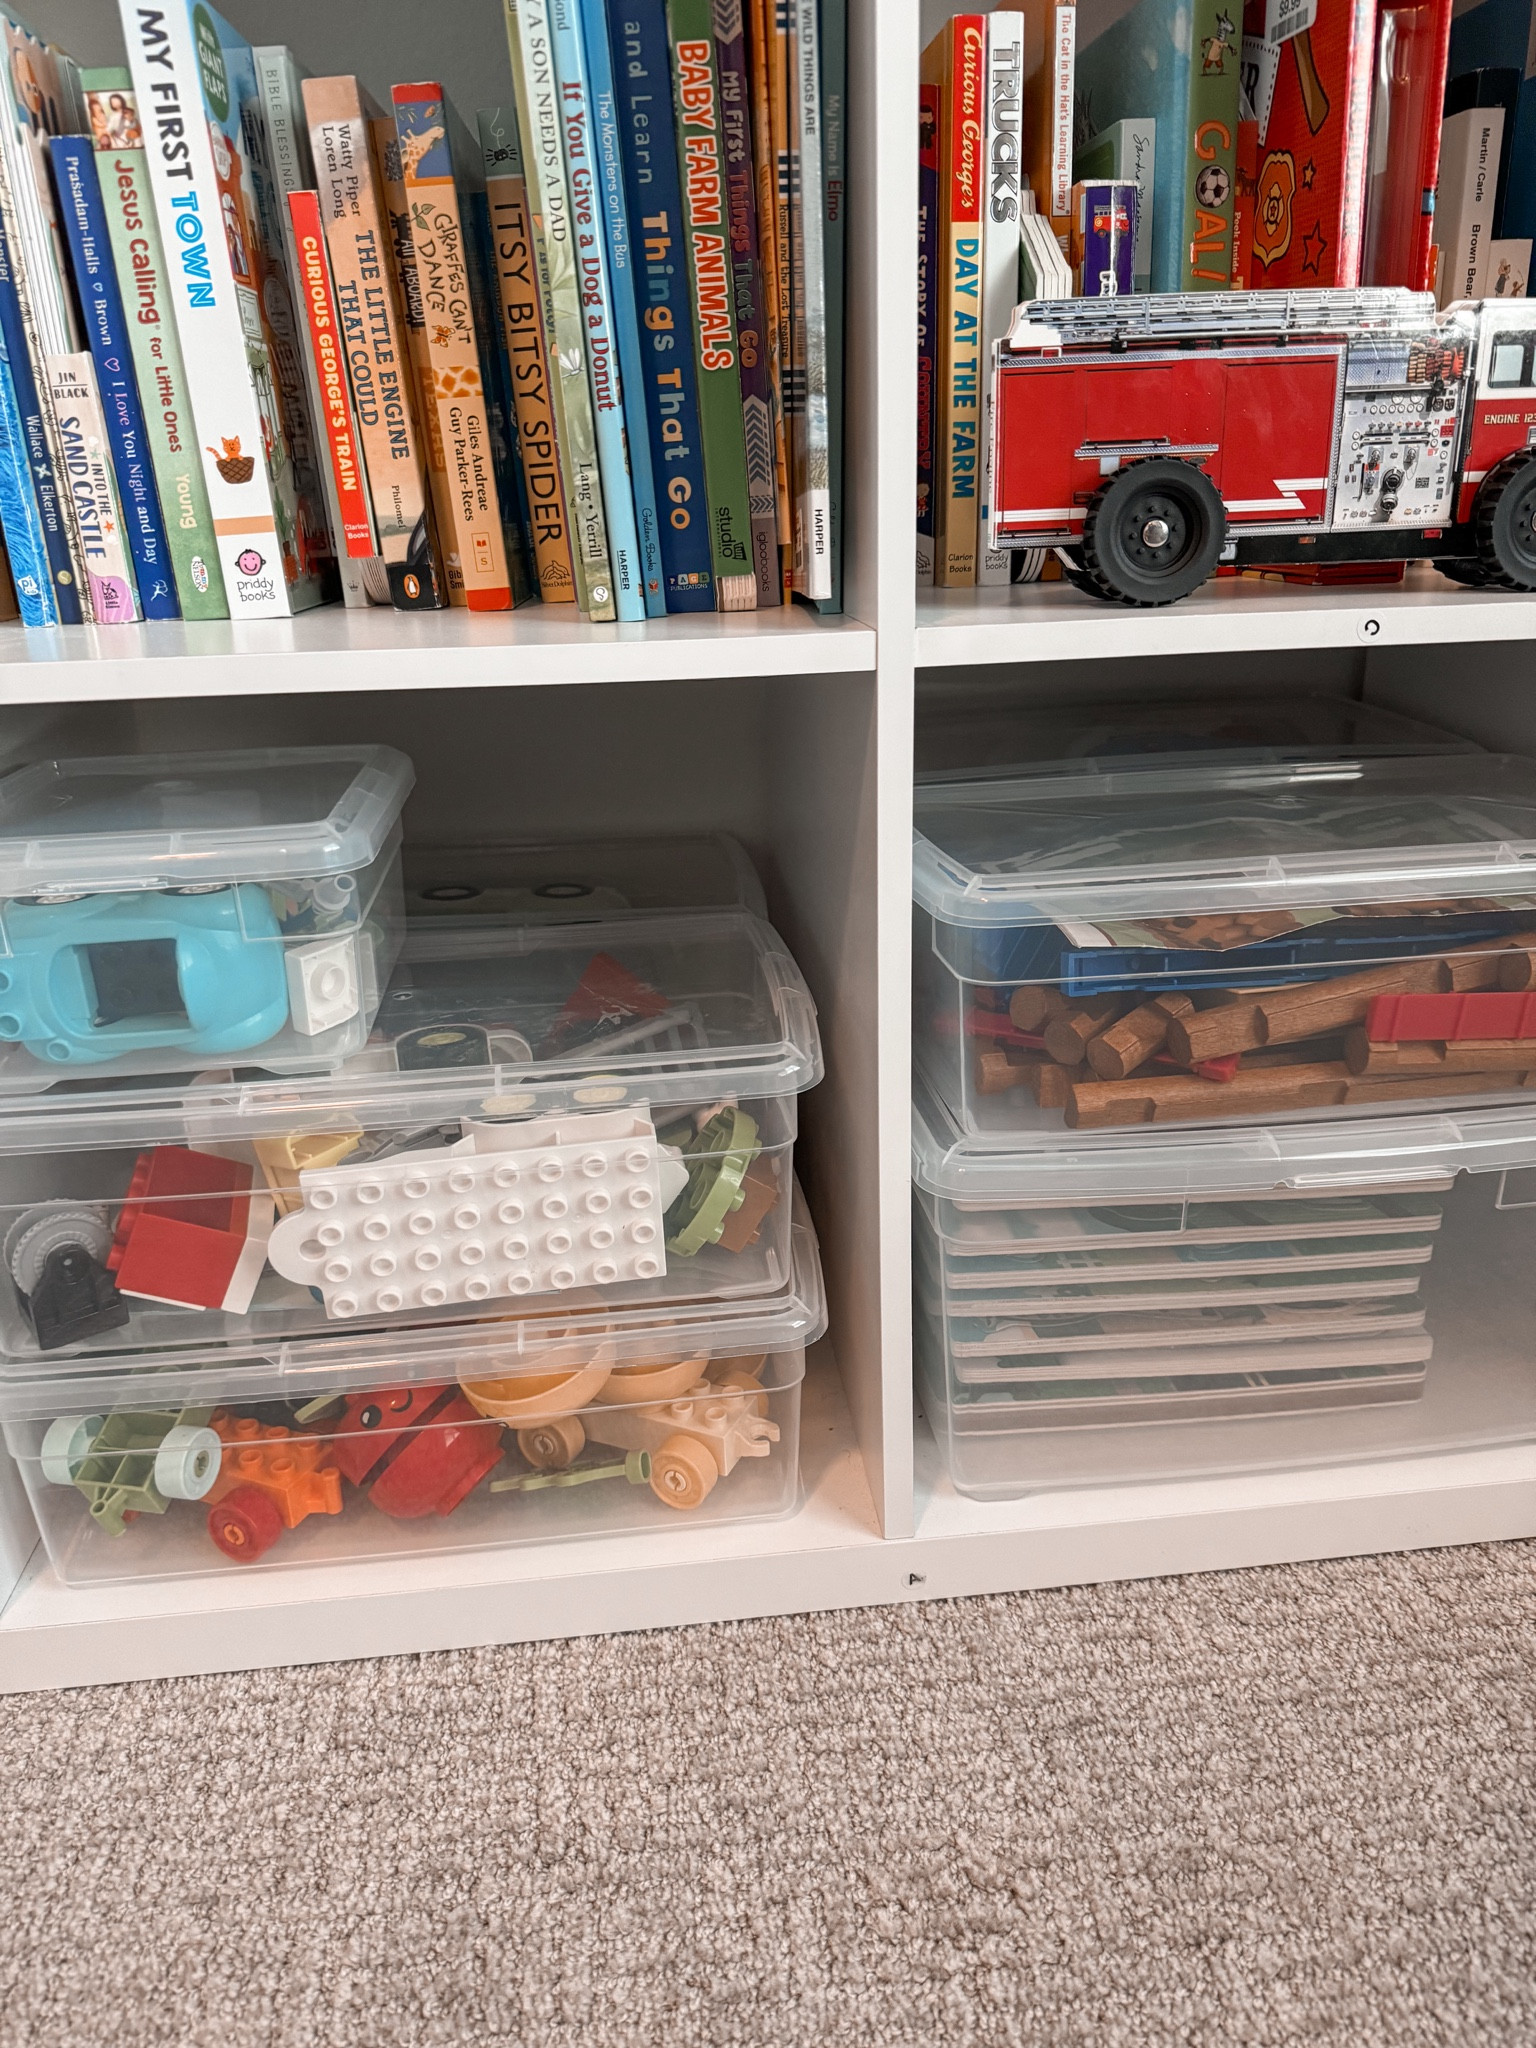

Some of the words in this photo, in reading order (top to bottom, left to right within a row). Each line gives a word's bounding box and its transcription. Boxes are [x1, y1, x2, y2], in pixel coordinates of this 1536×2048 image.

[528, 14, 543, 29] A
[555, 0, 571, 31] ond
[802, 7, 813, 45] WILD
[1062, 14, 1072, 33] The
[137, 8, 174, 71] MY
[531, 38, 550, 84] SON
[624, 21, 648, 79] and
[1061, 38, 1071, 57] Cat
[203, 69, 227, 105] FLAPS
[676, 39, 716, 131] BABY
[721, 71, 741, 102] My
[803, 50, 815, 103] THINGS
[962, 26, 983, 115] Curious
[1060, 60, 1070, 70] in
[1060, 74, 1070, 91] the
[266, 69, 283, 112] BIBLE
[562, 82, 585, 101] If
[597, 91, 610, 119] The
[1060, 95, 1070, 120] Hat's
[150, 83, 194, 181] FIRST
[537, 92, 559, 166] NEEDS
[563, 111, 585, 159] You
[631, 95, 654, 185] Learn
[726, 109, 745, 163] First
[805, 107, 816, 136] ARE
[828, 122, 840, 161] Name
[990, 41, 1021, 224] TRUCKS
[601, 122, 617, 193] Monsters
[955, 119, 980, 209] George's
[1057, 125, 1069, 170] Learning
[1480, 128, 1491, 164] Martin
[322, 126, 336, 173] Loren
[332, 179, 347, 219] Long
[337, 124, 352, 170] Watty
[346, 175, 361, 217] Piper
[545, 173, 560, 188] A
[684, 134, 723, 226] FARM
[1056, 174, 1068, 210] Library
[1475, 173, 1486, 202] Carle
[114, 159, 143, 231] Jesus
[572, 168, 593, 225] Give
[609, 194, 618, 212] on
[728, 170, 750, 252] Things
[827, 180, 842, 223] Elmo
[548, 197, 567, 242] DAD
[579, 234, 594, 248] a
[610, 216, 623, 239] the
[779, 205, 790, 238] Russell
[171, 191, 216, 308] TOWN
[355, 230, 380, 281] THE
[434, 213, 466, 294] GIRAFFES
[495, 203, 531, 285] ITSY
[614, 244, 626, 268] Bus
[780, 243, 790, 262] and
[1232, 241, 1240, 273] Inside
[1469, 224, 1481, 263] Brown
[417, 238, 446, 313] DANCE
[581, 258, 603, 307] Dog
[642, 211, 674, 352] Things
[734, 258, 756, 321] That
[781, 265, 791, 285] the
[955, 239, 980, 298] DAY
[1464, 268, 1477, 299] Bear,
[339, 280, 367, 344] THAT
[449, 299, 472, 344] CAN'T
[587, 314, 603, 329] a
[693, 232, 735, 371] ANIMALS
[781, 287, 791, 312] Lost
[94, 299, 112, 346] Brown
[364, 286, 396, 364] LITTLE
[782, 314, 791, 358] Treasure
[954, 311, 977, 347] AT
[150, 337, 163, 360] for
[302, 235, 331, 328] CURIOUS
[319, 333, 347, 430] GEORGE'S
[335, 432, 357, 491] TRAIN
[507, 303, 546, 405] BITSY
[54, 387, 89, 400] BLACK
[155, 367, 177, 407] Little
[351, 351, 378, 426] COULD
[590, 338, 614, 412] Donut
[953, 358, 977, 409] THE
[113, 392, 130, 426] Love
[378, 372, 410, 460] ENGINE
[449, 406, 462, 435] Guy
[657, 368, 690, 461] That
[1484, 413, 1520, 425] ENGINE
[60, 416, 88, 477] SAND
[121, 431, 137, 459] You
[163, 412, 182, 453] Ones
[467, 415, 481, 449] Giles
[26, 415, 43, 459] Wallace
[40, 485, 57, 532] Elkerton
[91, 463, 107, 492] INTO
[454, 439, 474, 522] Parker-Rees
[472, 452, 488, 511] Andreae
[952, 421, 976, 498] FARM
[98, 493, 112, 515] THE
[128, 464, 149, 502] Night
[175, 473, 198, 529] Young
[523, 421, 562, 546] SPIDER
[72, 481, 106, 559] CASTLE
[136, 507, 156, 534] and
[344, 523, 369, 531] Clarion
[392, 485, 406, 529] Philomel
[579, 462, 593, 501] Lang
[586, 513, 602, 558] Yerrill
[142, 537, 158, 566] Day
[347, 532, 369, 540] Books
[719, 506, 736, 558] studio
[815, 509, 824, 555] HARPER
[619, 550, 630, 591] HARPER
[757, 531, 770, 591] igloobooks
[948, 553, 974, 562] Clarion
[949, 565, 972, 573] Books
[985, 554, 1009, 563] priddy
[985, 562, 1008, 571] books
[237, 577, 274, 592] priddy
[239, 591, 276, 602] books
